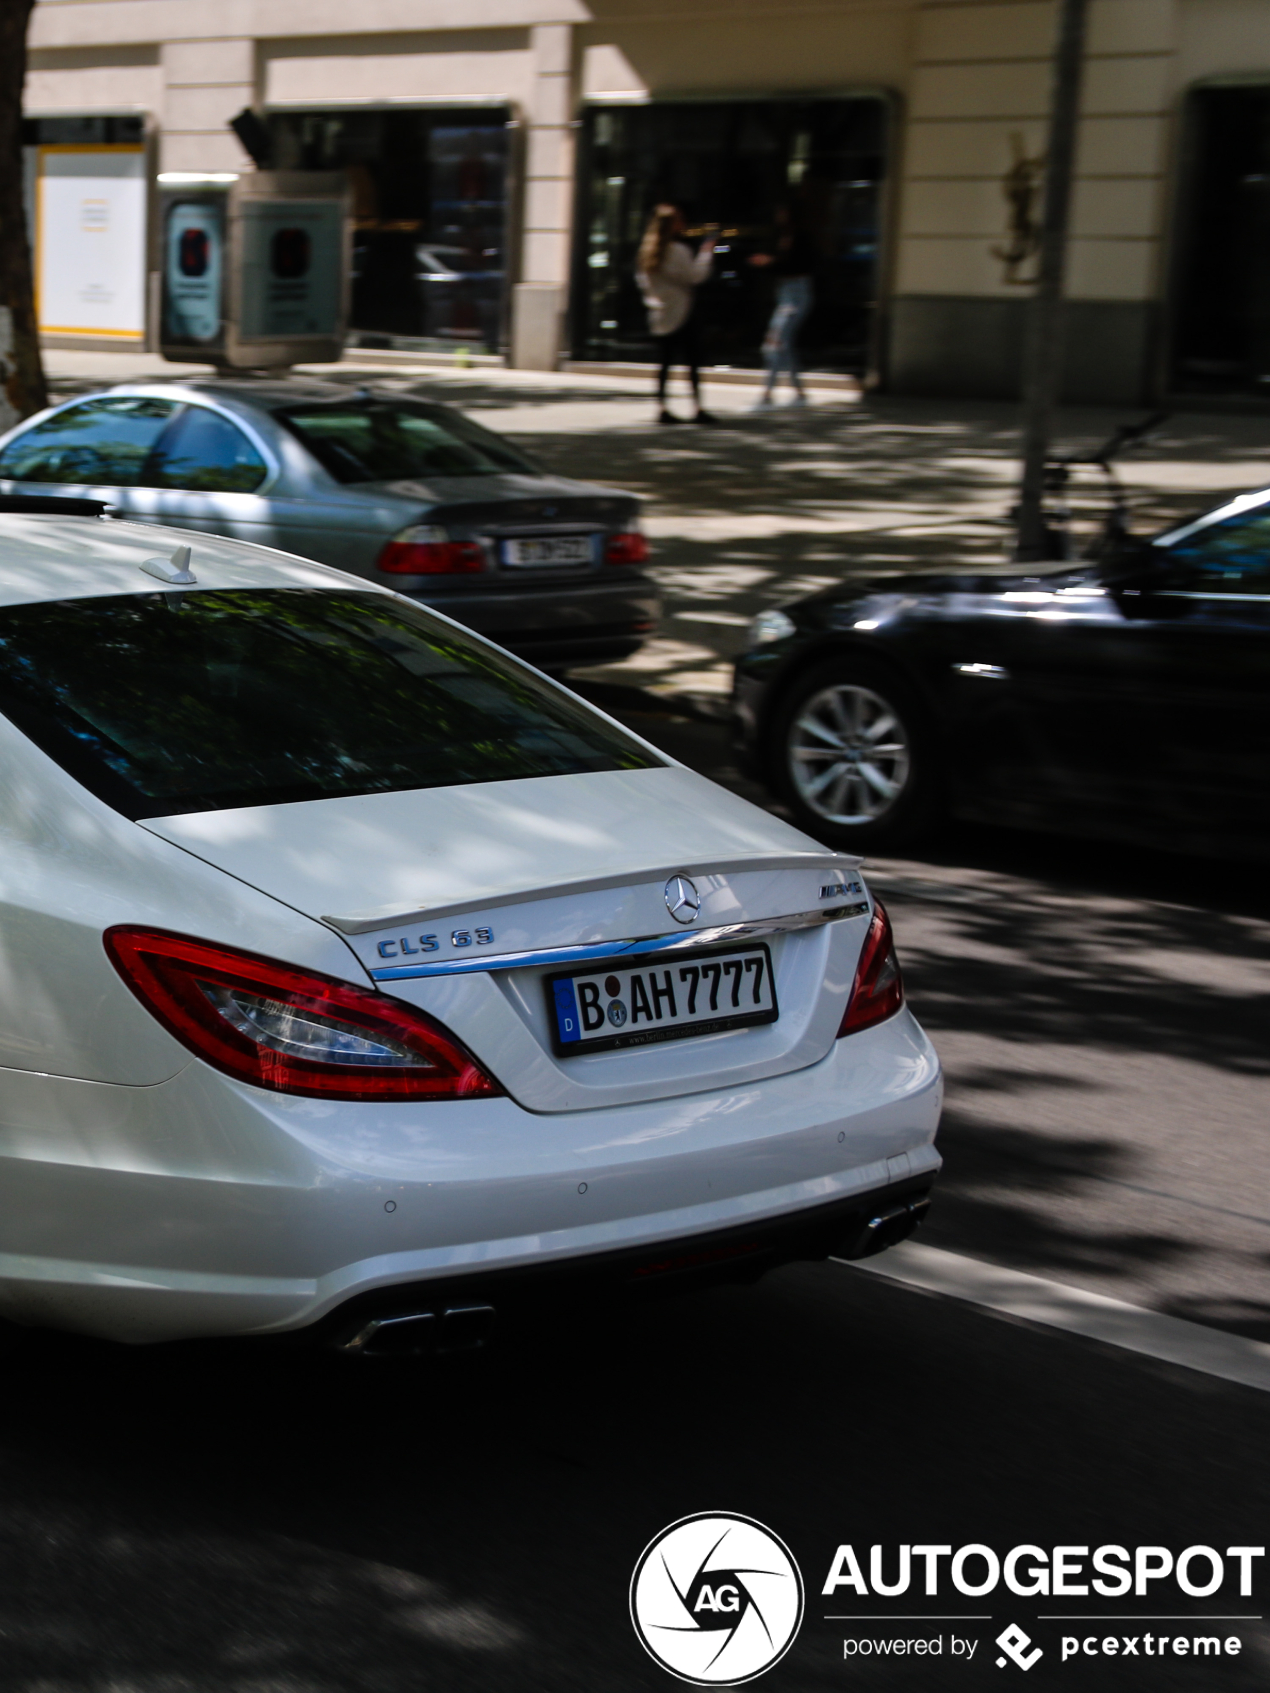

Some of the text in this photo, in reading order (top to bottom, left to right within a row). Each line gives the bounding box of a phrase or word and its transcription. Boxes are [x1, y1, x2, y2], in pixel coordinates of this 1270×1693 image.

[377, 926, 495, 958] CLS 63
[564, 1018, 574, 1032] D
